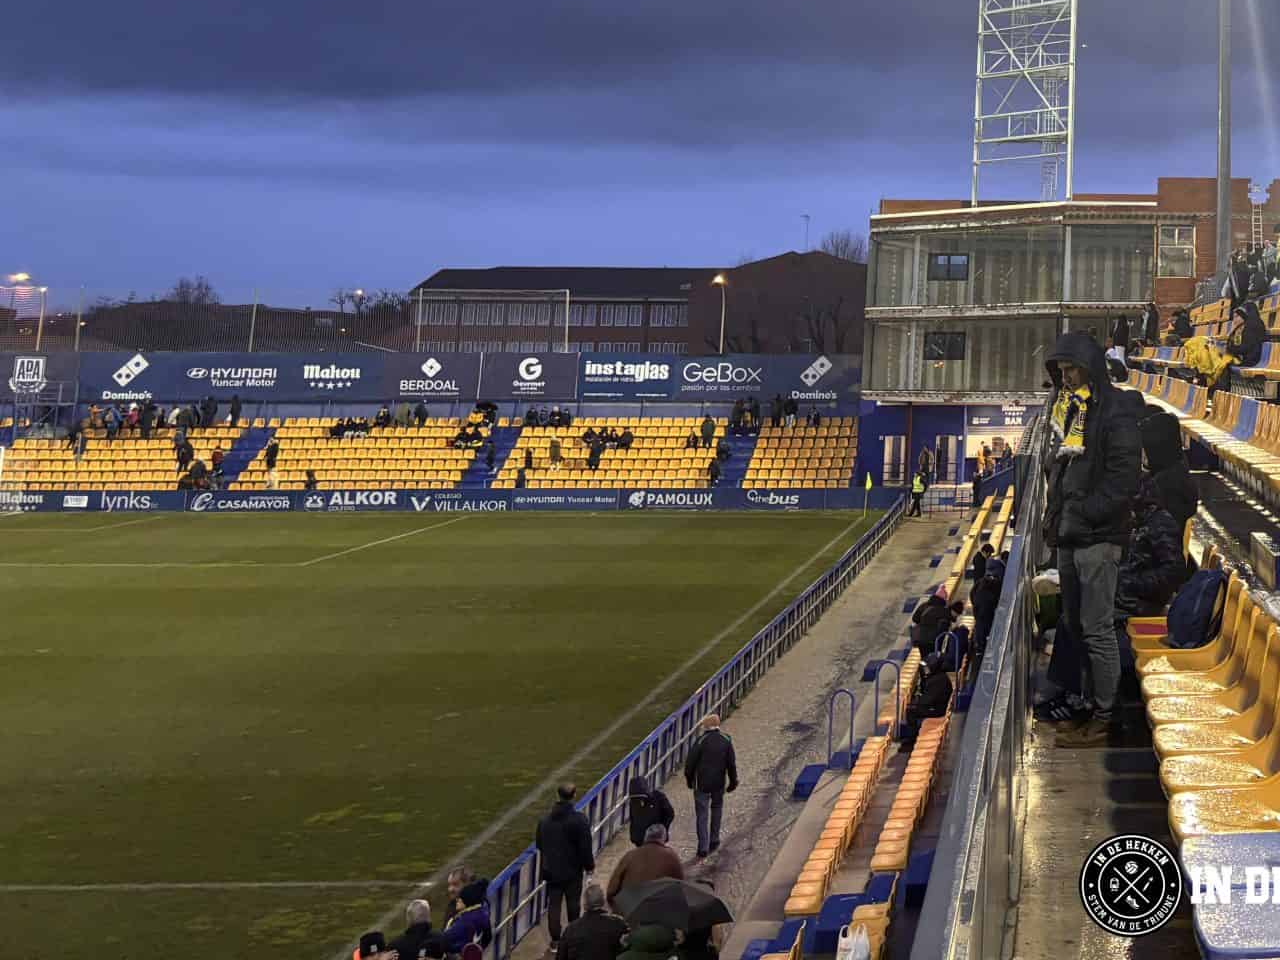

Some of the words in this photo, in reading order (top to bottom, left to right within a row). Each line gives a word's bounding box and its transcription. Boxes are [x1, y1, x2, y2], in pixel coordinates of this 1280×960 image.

[211, 368, 277, 379] HYUNDAI
[304, 364, 360, 379] Mahou
[585, 361, 669, 382] instaglas
[683, 363, 761, 382] GeBox
[211, 379, 243, 388] Yuncar
[246, 379, 275, 388] Motor
[400, 380, 459, 391] BERDOAL
[102, 389, 152, 400] Domino's
[792, 390, 837, 400] Domino's
[101, 491, 150, 512] lynks
[330, 491, 397, 505] ALKOR
[647, 493, 713, 505] PAMOLUX
[218, 500, 290, 509] CASAMAYOR
[434, 500, 507, 511] VILLALKOR
